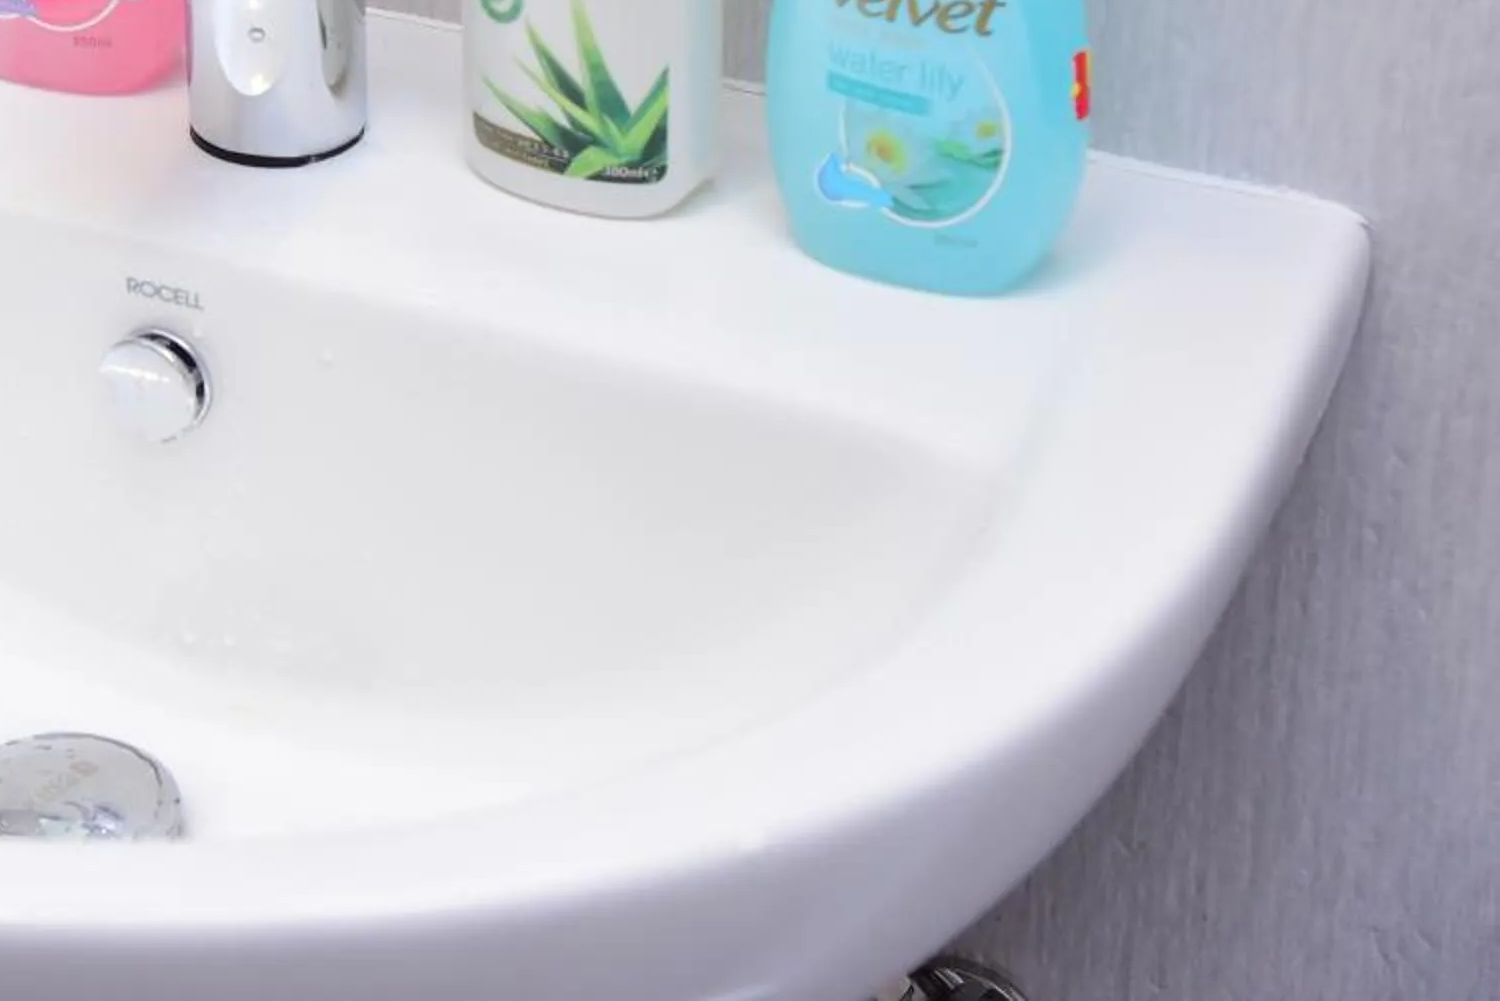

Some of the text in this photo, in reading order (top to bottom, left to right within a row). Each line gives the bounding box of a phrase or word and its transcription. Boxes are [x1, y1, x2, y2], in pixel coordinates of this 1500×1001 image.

[827, 40, 907, 83] water
[921, 60, 966, 102] lily
[126, 276, 204, 311] ROCELL
